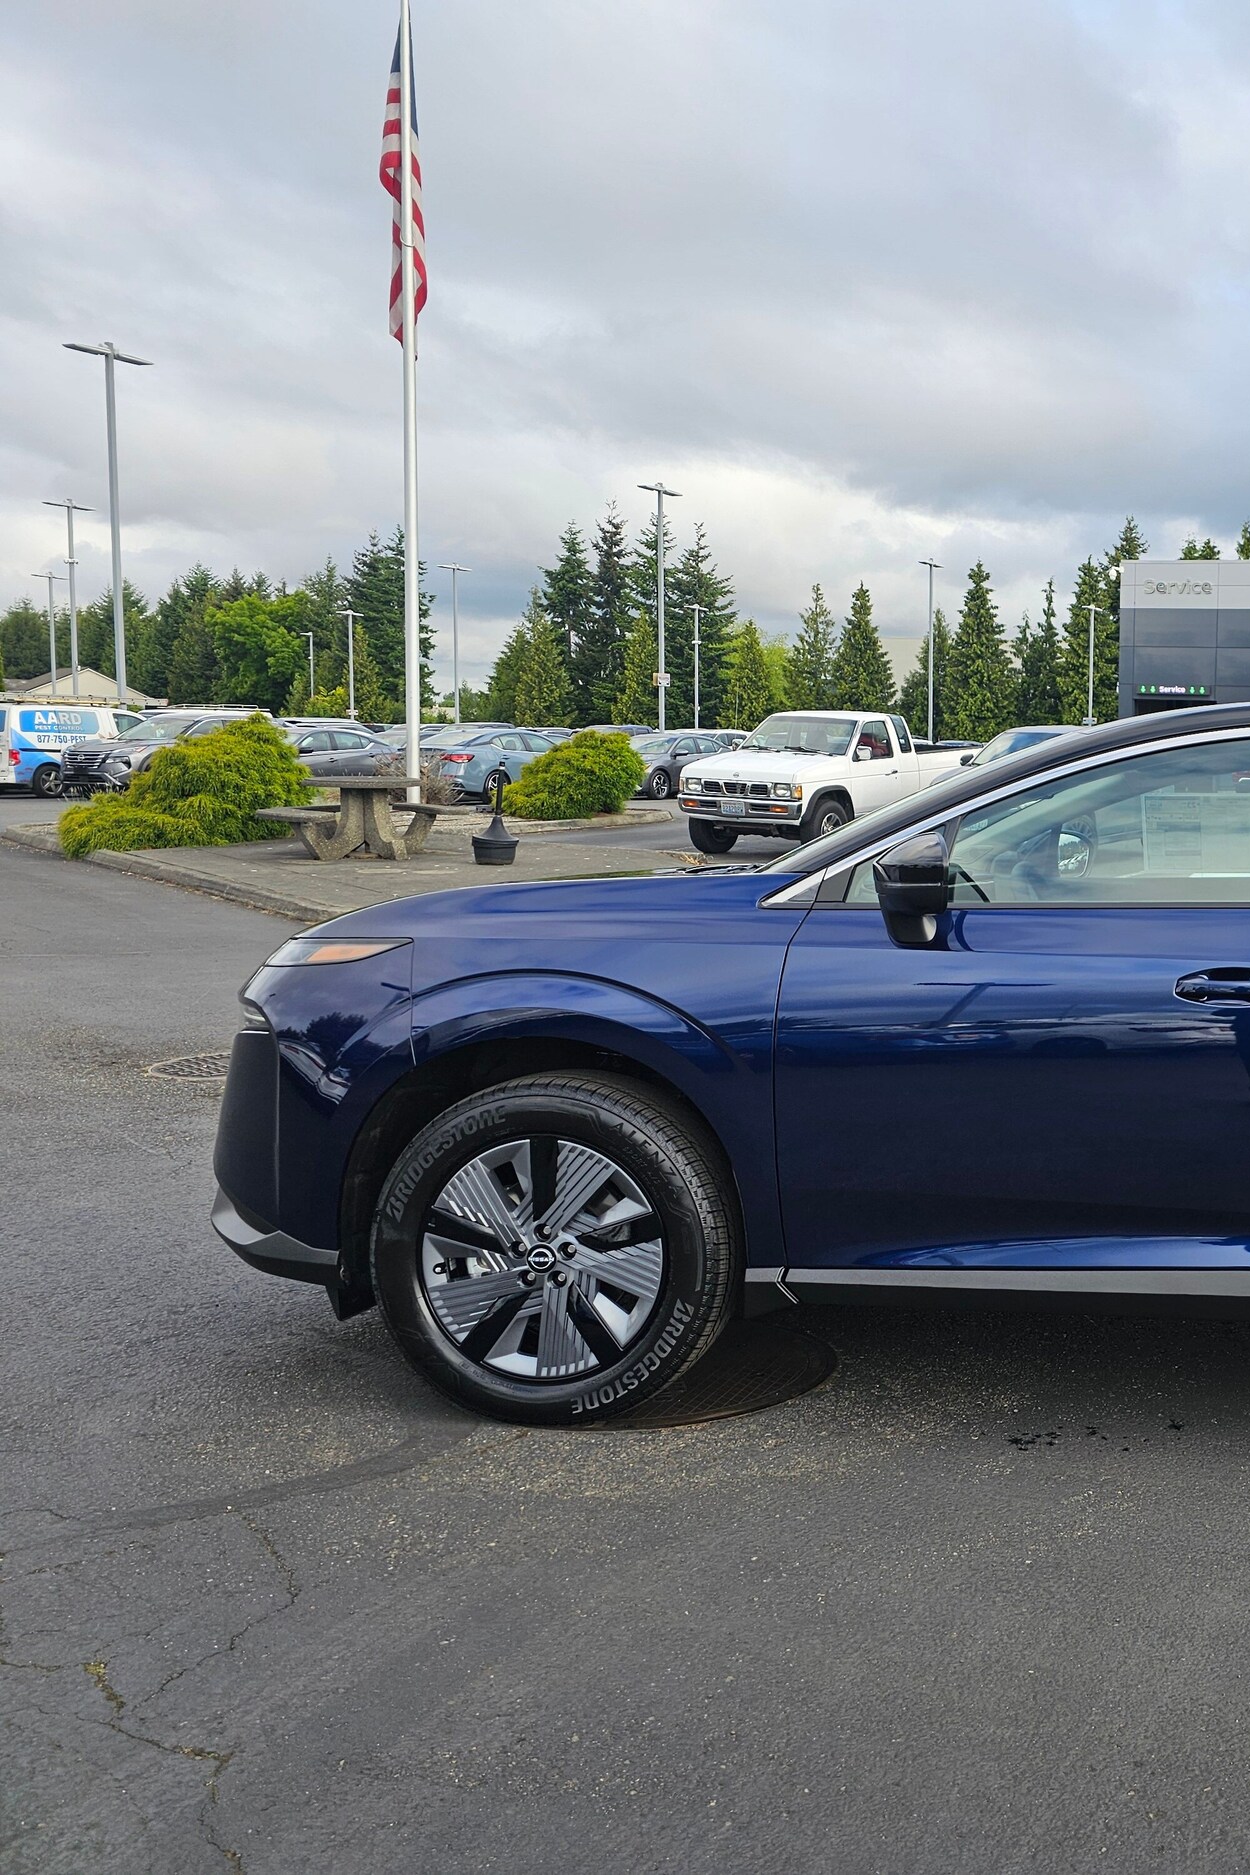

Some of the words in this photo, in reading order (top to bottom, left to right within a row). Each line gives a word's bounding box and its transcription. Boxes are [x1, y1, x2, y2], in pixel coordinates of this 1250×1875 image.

[1143, 579, 1212, 595] Service
[1159, 685, 1186, 694] Service
[34, 711, 82, 725] AARD
[37, 735, 87, 744] 877-750-PEST
[385, 1105, 507, 1223] BRIDGESTONE
[608, 1122, 684, 1199] ALENZA
[570, 1299, 694, 1414] BRIDGESTONE
